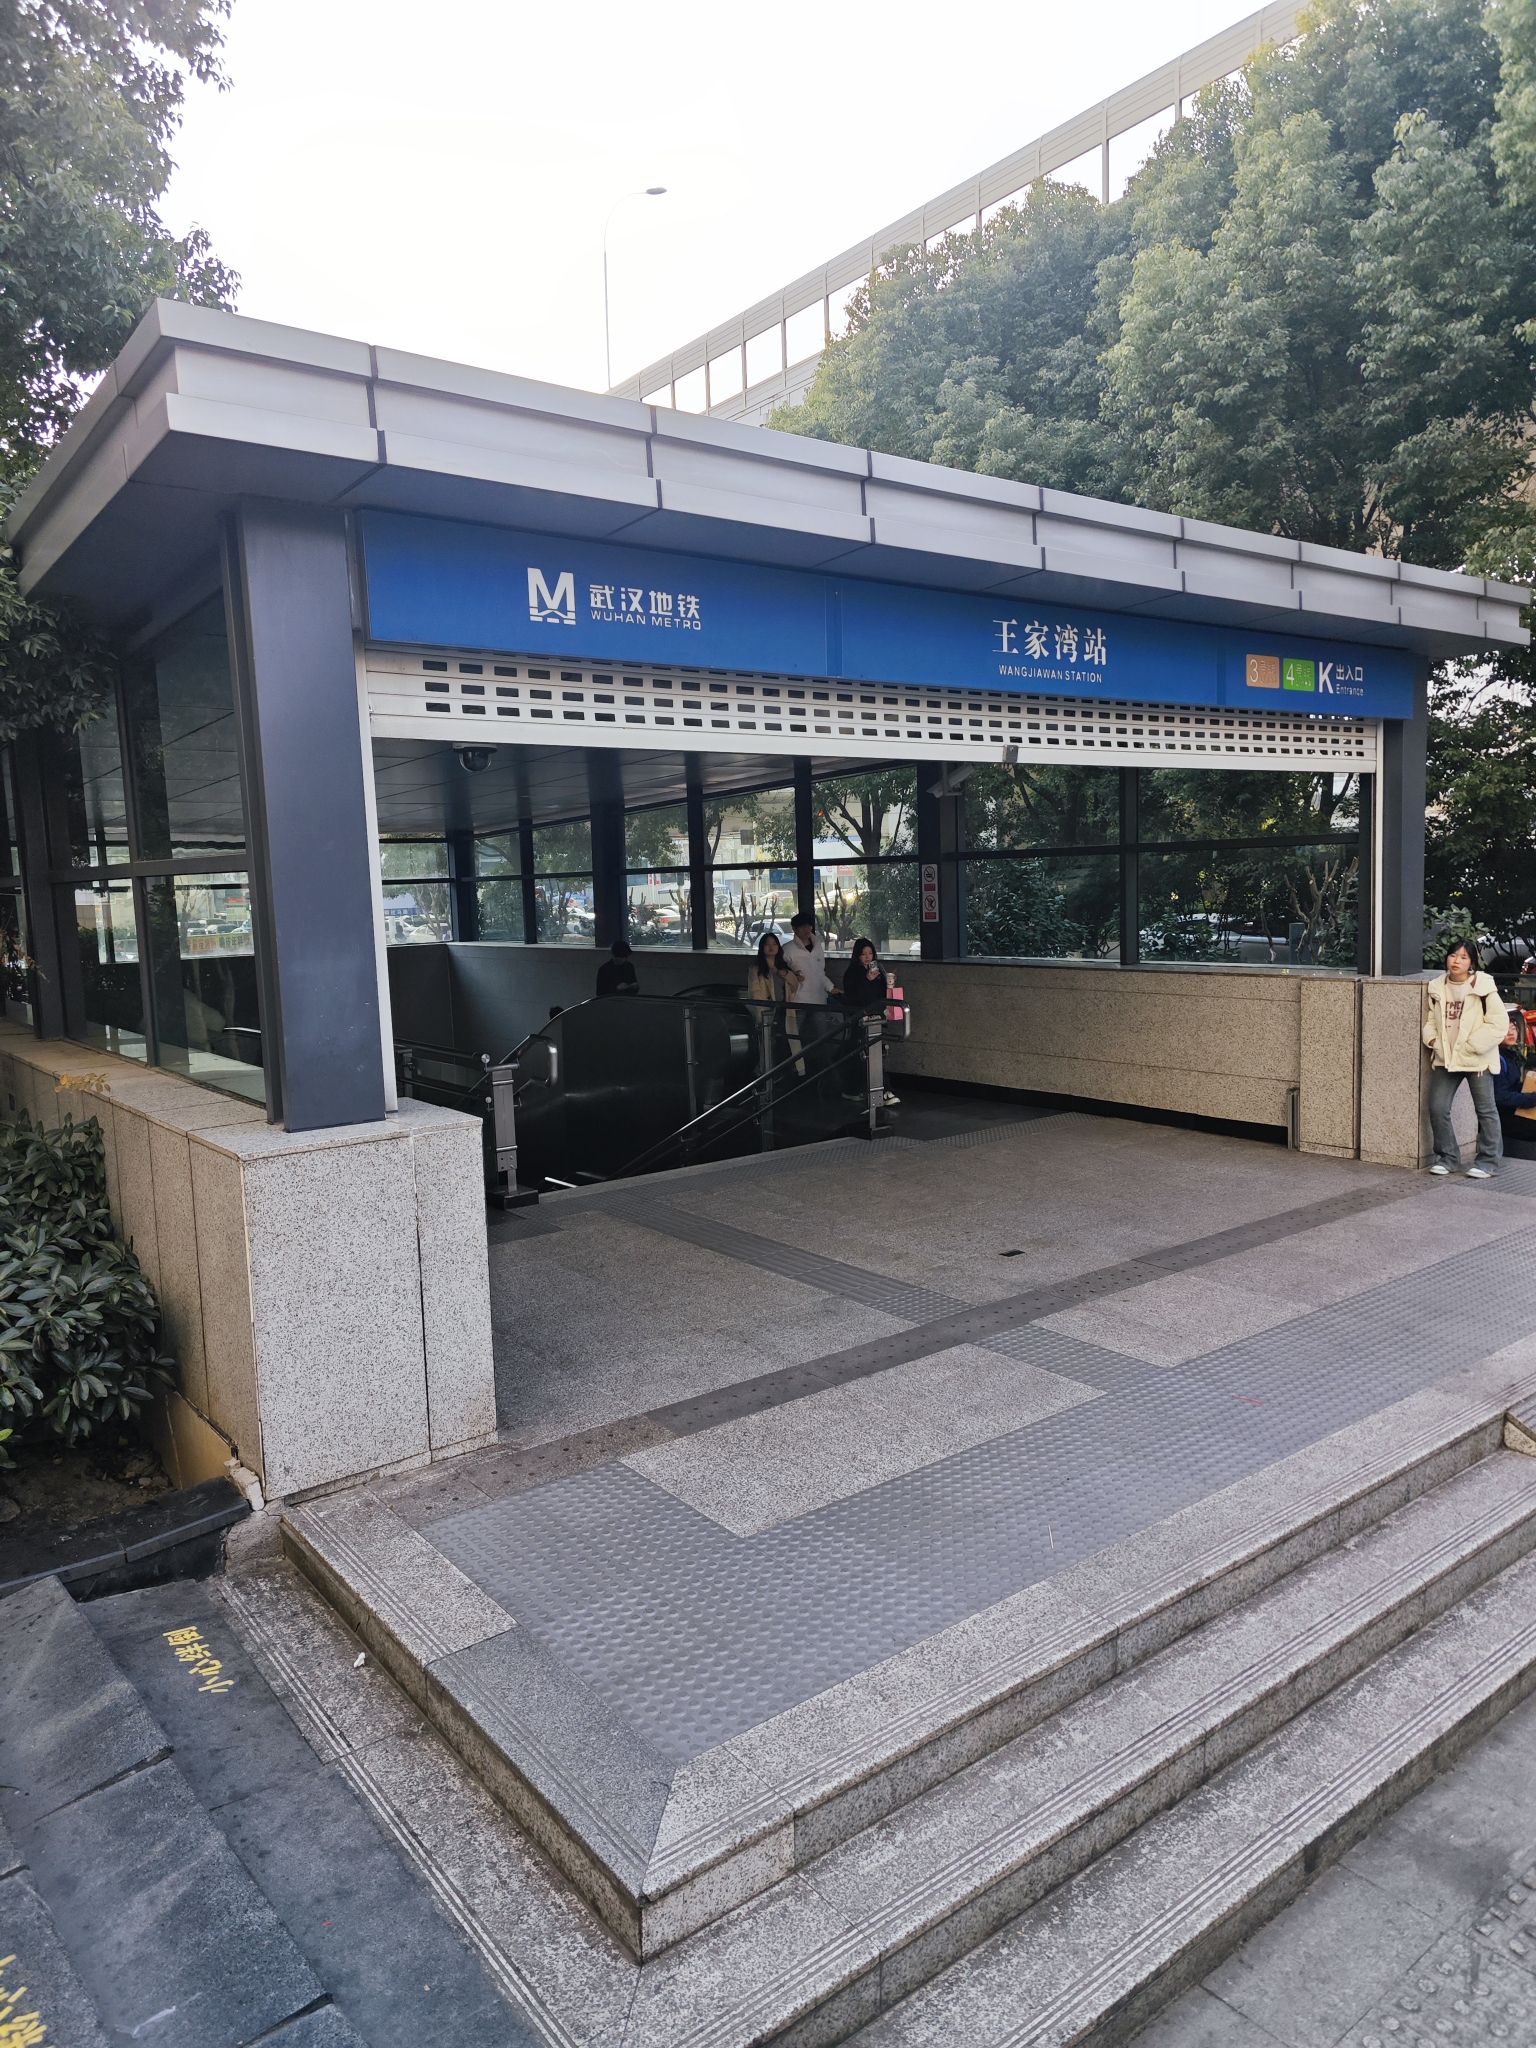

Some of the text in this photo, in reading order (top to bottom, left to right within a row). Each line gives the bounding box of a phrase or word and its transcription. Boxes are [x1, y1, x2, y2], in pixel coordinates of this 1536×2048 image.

[589, 584, 700, 619] 武汉地铁
[591, 609, 702, 630] WUHAN METRO
[992, 618, 1107, 666] 王家湾站
[999, 664, 1102, 684] WANGJIAWAN STATION
[1250, 658, 1259, 683] 3
[1286, 663, 1295, 686] 4
[1318, 661, 1334, 694] K
[1336, 664, 1364, 682] 出入口
[1336, 684, 1364, 697] Entrance
